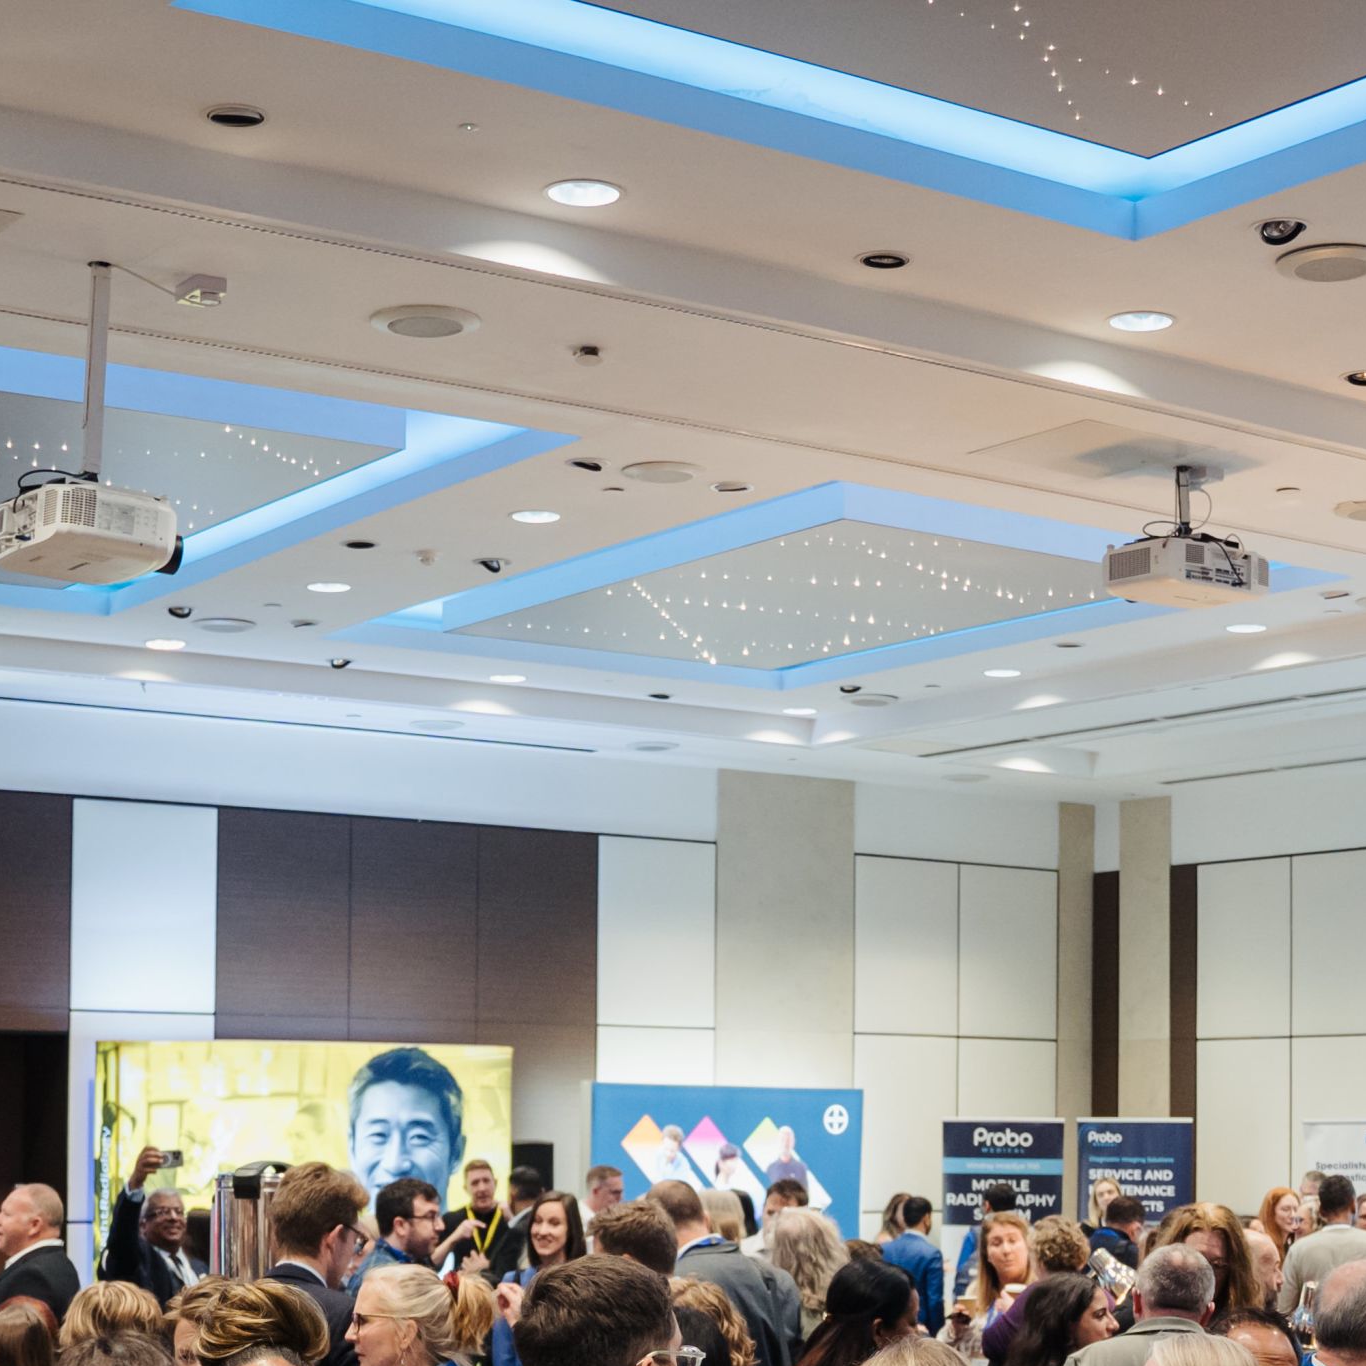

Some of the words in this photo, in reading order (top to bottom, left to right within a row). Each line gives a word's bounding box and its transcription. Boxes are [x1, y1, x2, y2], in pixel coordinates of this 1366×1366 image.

[973, 1127, 1034, 1147] Probo
[1087, 1130, 1123, 1143] Probo
[1315, 1162, 1366, 1170] Specialists
[1088, 1168, 1142, 1180] SERVICE
[1144, 1169, 1174, 1181] AND
[971, 1179, 1030, 1192] MOLE
[946, 1193, 1056, 1207] RADIAPHY
